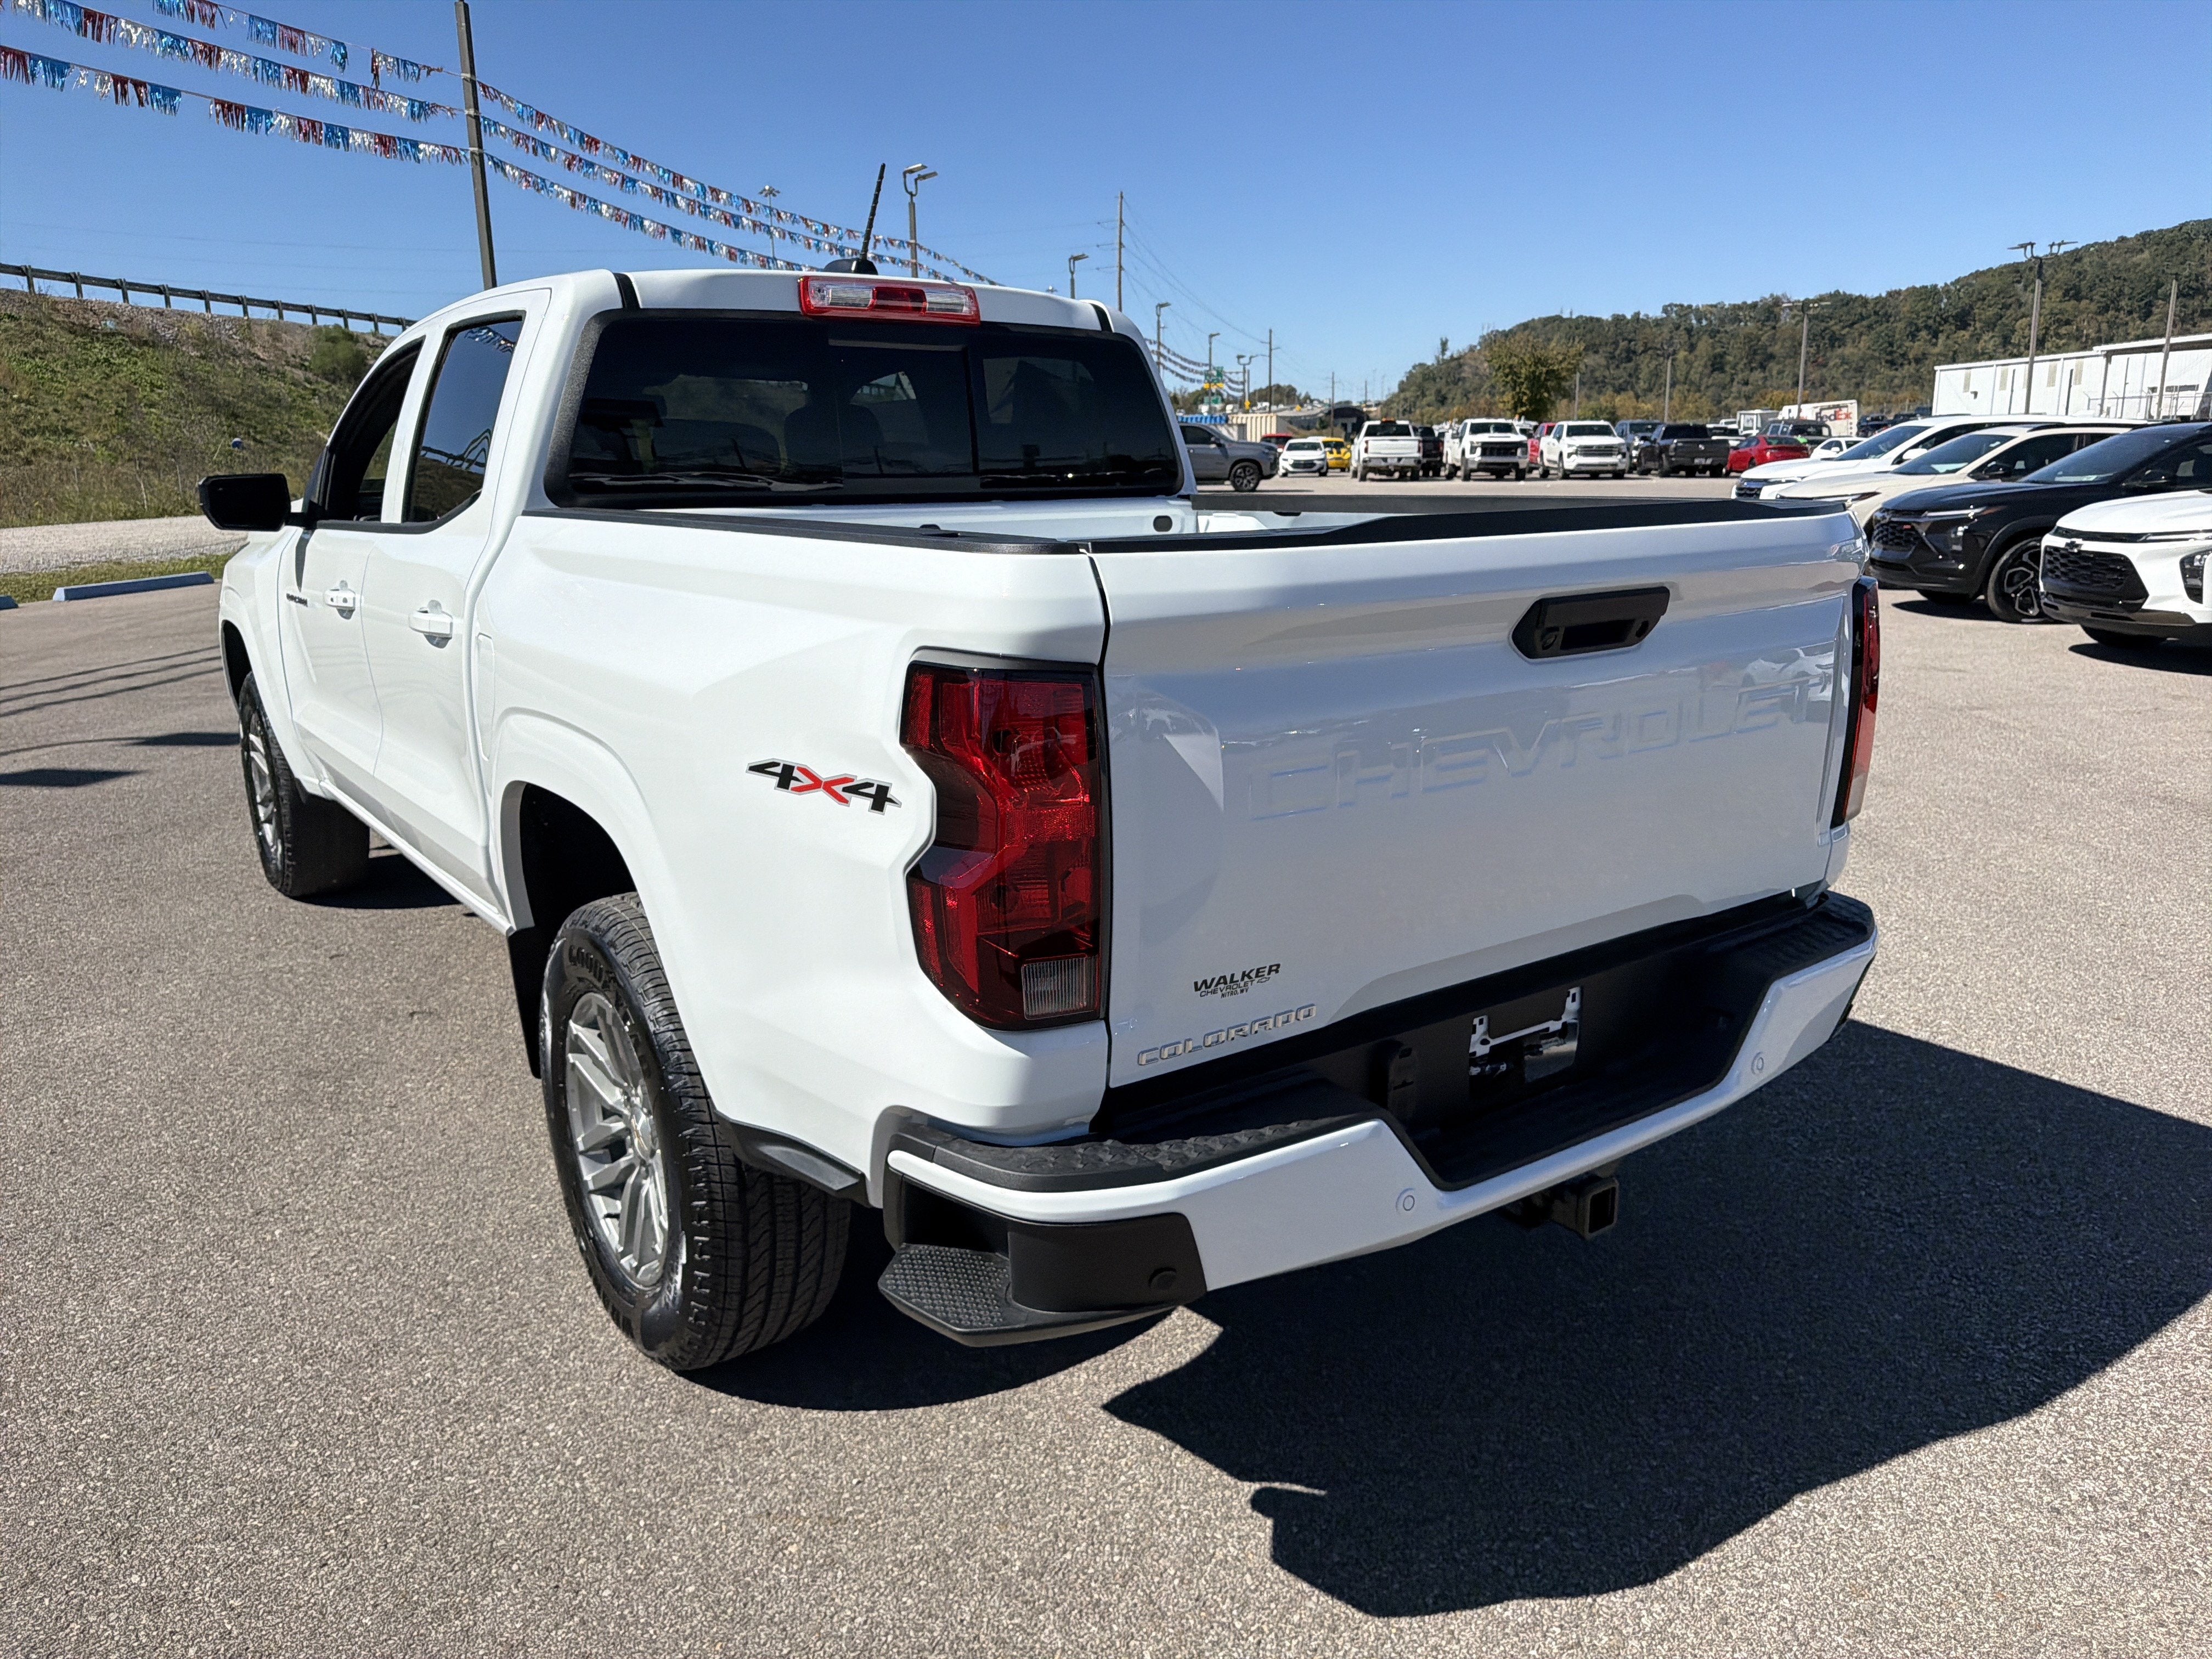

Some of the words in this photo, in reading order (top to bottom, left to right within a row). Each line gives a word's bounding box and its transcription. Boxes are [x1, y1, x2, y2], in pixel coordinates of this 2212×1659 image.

[1249, 672, 1825, 821] CHEVROLET
[1194, 963, 1280, 992] WALKER
[1200, 979, 1255, 997] CHEVROLET
[1137, 1003, 1317, 1065] COLORADO
